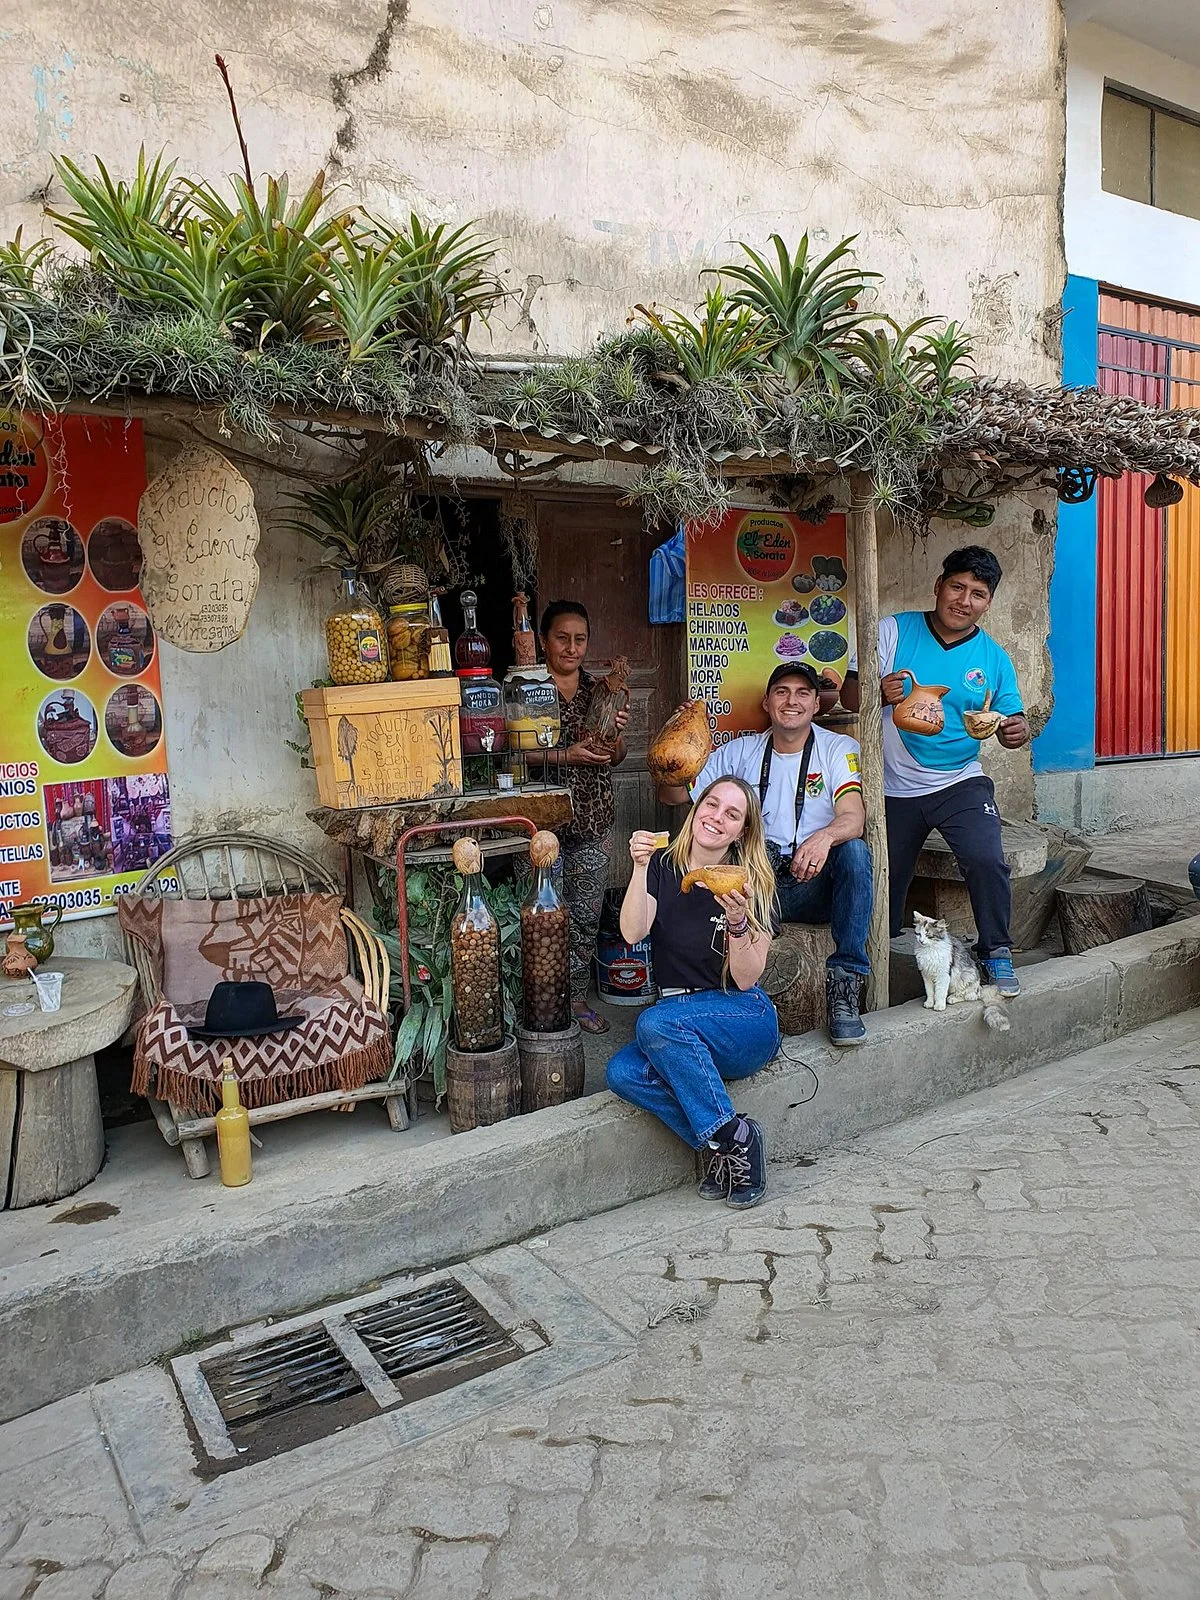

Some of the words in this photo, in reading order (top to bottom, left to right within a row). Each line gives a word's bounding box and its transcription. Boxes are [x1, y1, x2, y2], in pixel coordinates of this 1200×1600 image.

[144, 478, 250, 538] Productos
[750, 518, 784, 529] Productos
[743, 530, 759, 547] El
[763, 532, 792, 549] Edén
[753, 550, 786, 561] Sorata
[166, 568, 244, 602] Sorata
[688, 584, 708, 598] LES
[710, 585, 757, 599] OFRECE
[688, 602, 740, 618] HELADOS
[689, 620, 749, 635] CHIRIMOYA
[689, 637, 750, 652] MARACUYA
[690, 654, 729, 668] TUMBO
[690, 670, 723, 684] MORA
[689, 685, 719, 699] CAFE
[706, 700, 731, 715] NGO
[360, 711, 423, 754] Productos
[612, 974, 644, 985] MONOPOL
